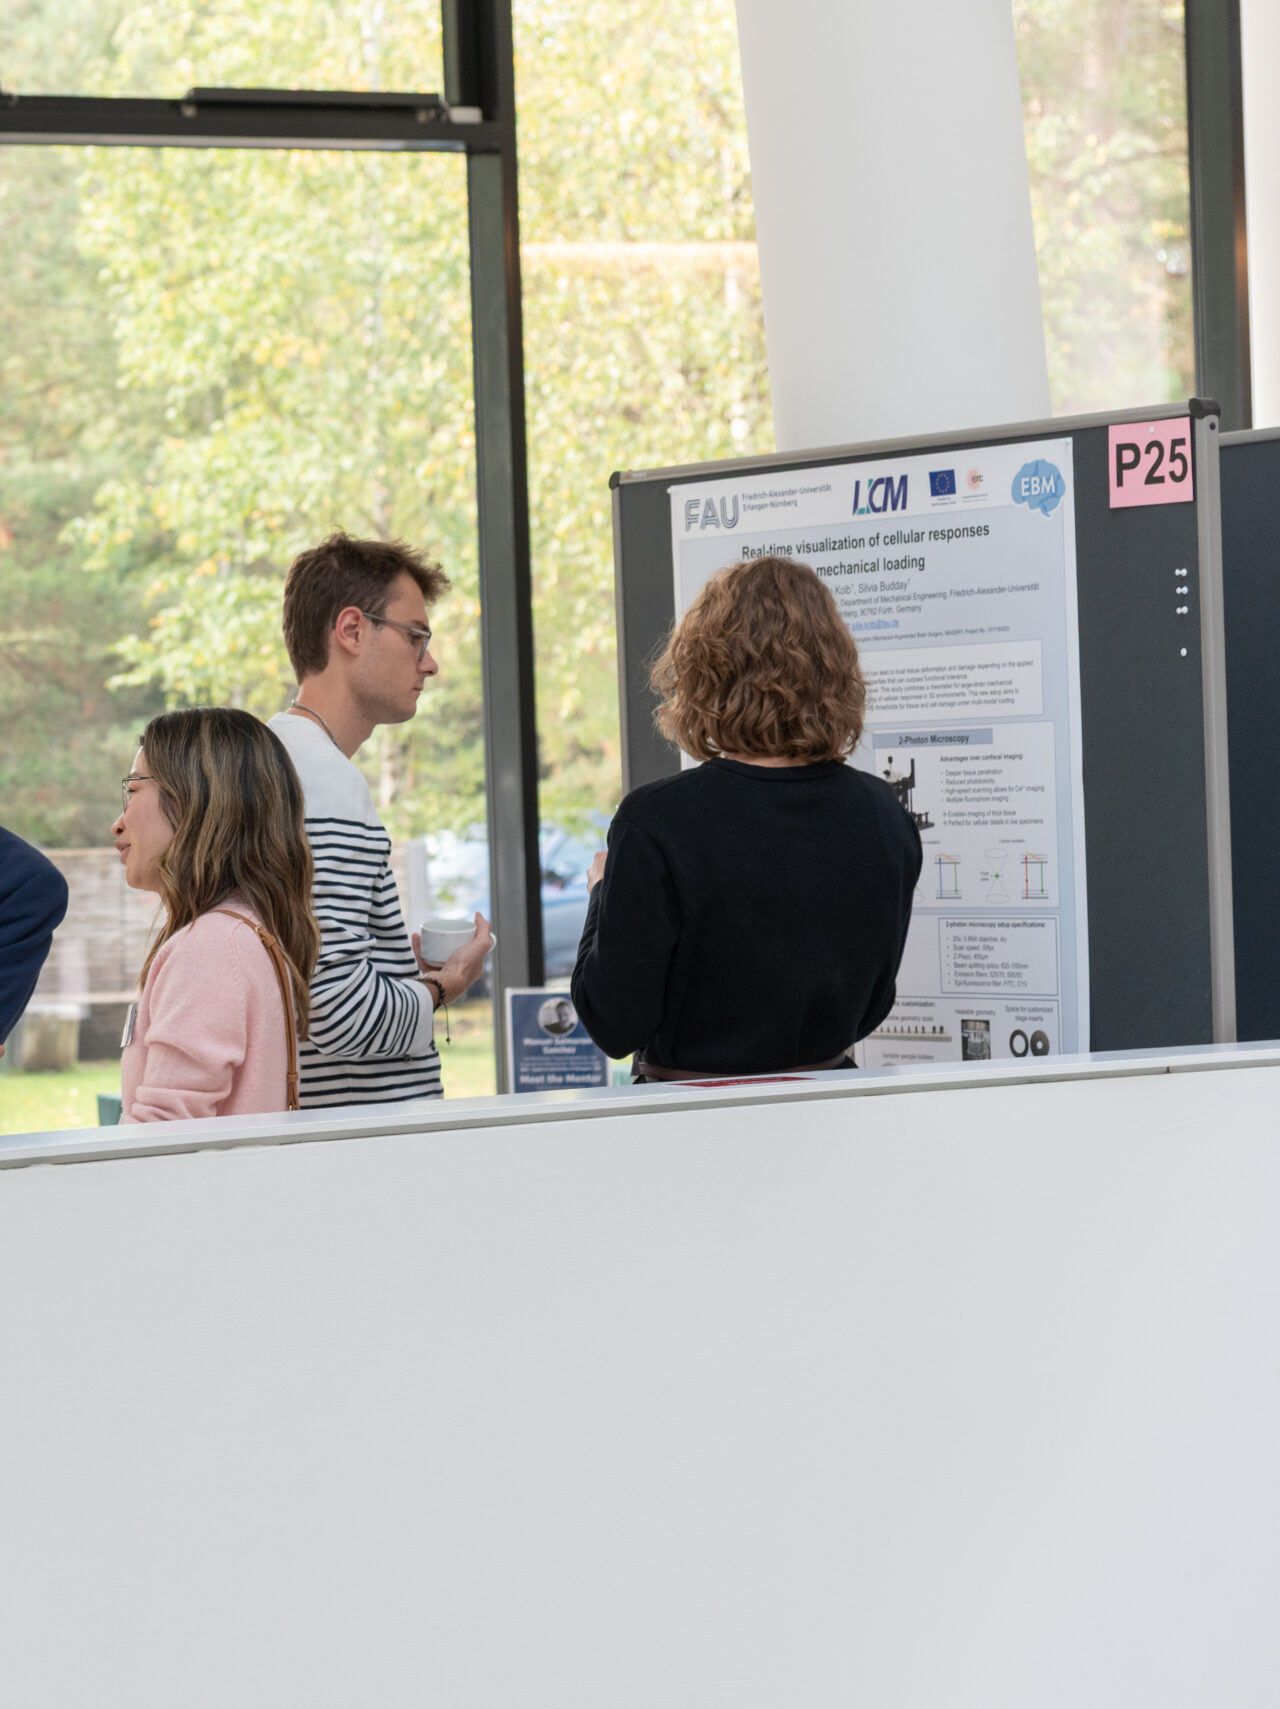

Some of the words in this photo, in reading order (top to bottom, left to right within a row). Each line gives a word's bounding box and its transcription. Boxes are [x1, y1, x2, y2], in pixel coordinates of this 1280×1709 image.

[1116, 437, 1188, 488] P25
[1021, 474, 1056, 497] EBM
[685, 494, 740, 532] FAU
[742, 484, 832, 500] Friedrich-Alexander-Universität
[743, 499, 798, 511] Erlangen-Nürnberg
[742, 543, 793, 560] Real-time
[796, 536, 866, 554] visualization
[870, 532, 880, 547] of
[884, 530, 925, 546] cellular
[928, 524, 990, 543] responses
[816, 559, 880, 577] mechanical
[884, 556, 925, 572] loading
[858, 583, 878, 593] Silvia
[898, 735, 928, 744] 2-Photon
[930, 734, 969, 743] Microscopy
